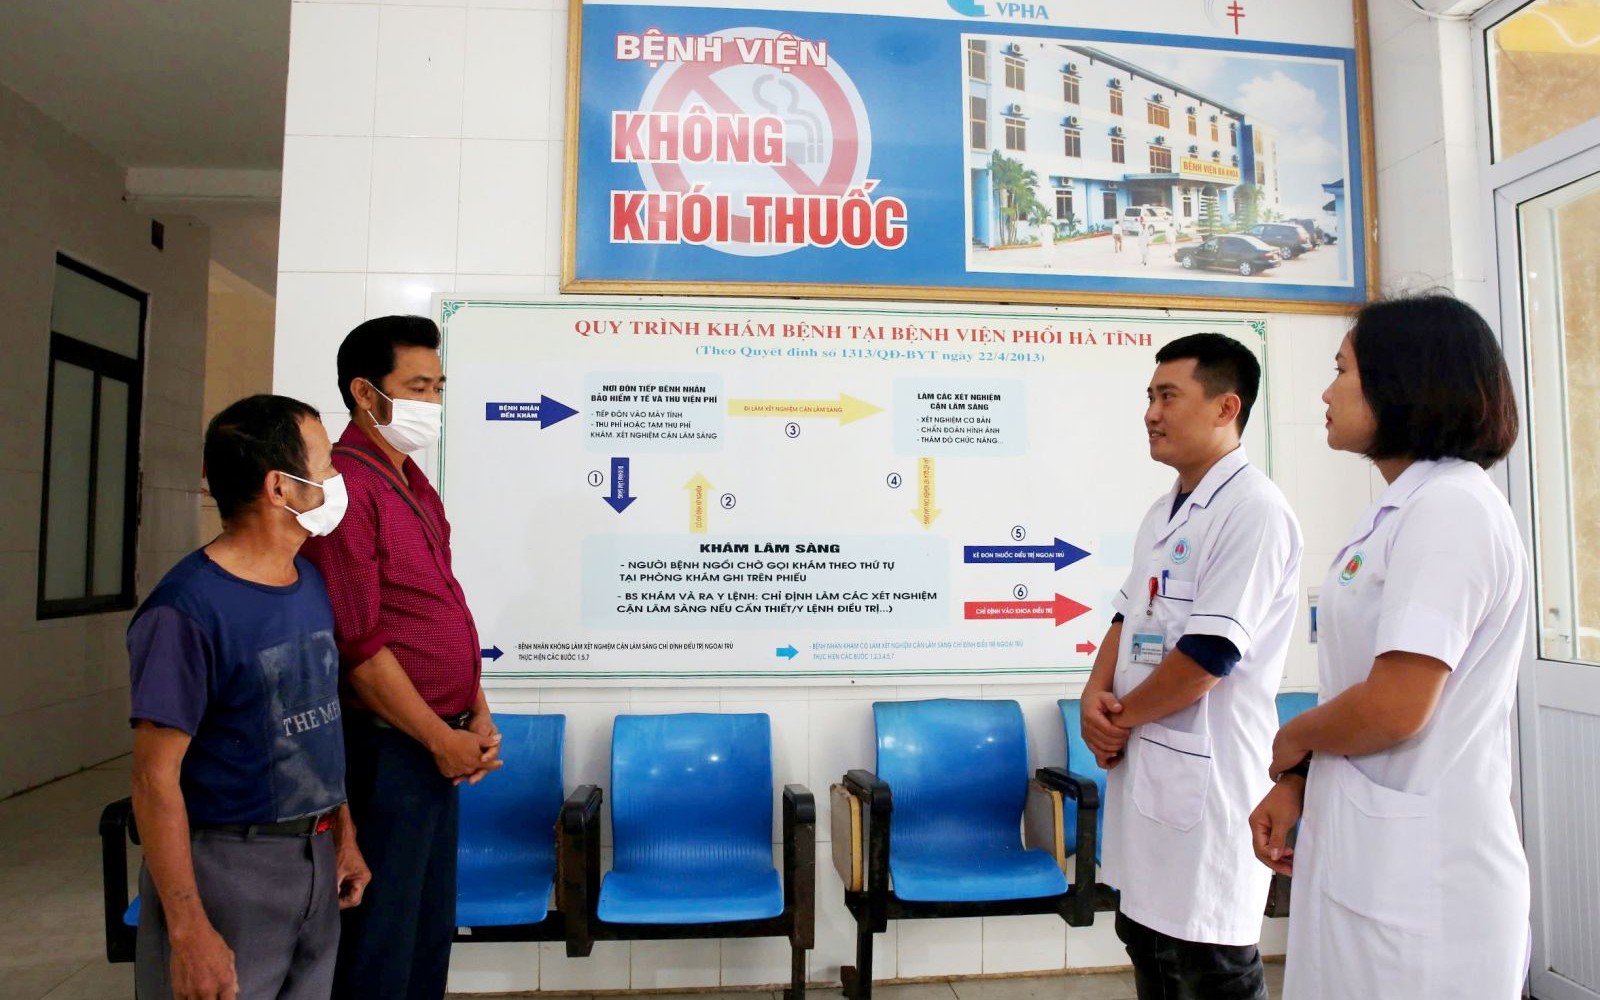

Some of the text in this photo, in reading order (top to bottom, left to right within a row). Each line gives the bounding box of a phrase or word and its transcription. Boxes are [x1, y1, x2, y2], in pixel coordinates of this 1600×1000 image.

[996, 2, 1049, 19] VPHA
[616, 27, 828, 74] BỆNH VIỆN
[611, 104, 786, 166] KHÔNG
[610, 179, 908, 250] KHÓI THUỐC
[574, 317, 1153, 347] QUY TRÌNH KHÁM BỆNH TẠI BỆNH VIỆN PHỔI HÀ TĨNH
[695, 345, 1045, 363] (Theo Quyết định số 1313/QĐ-BYT ngày 22/4/2013)
[699, 542, 841, 553] KHÁM LÂM SÀNG
[628, 559, 667, 569] NGƯỜI
[670, 559, 699, 571] BỆNH
[736, 559, 764, 569] CHỜ
[766, 561, 789, 571] GỌI
[792, 559, 826, 569] KHÁM
[828, 561, 857, 570] THEO
[859, 559, 880, 569] THỨ
[882, 561, 895, 571] TỰ
[619, 572, 807, 583] TẠI PHÒNG KHÁM GHI TRÊN PHIẾU
[625, 590, 937, 602] BS KHÁM VÀ RA Y LỆNH: CHỈ ĐỊNH LÀM CÁC XÉT NGHIỆM
[616, 603, 643, 614] CẬN
[646, 603, 671, 613] LÂM
[674, 603, 707, 613] SÀNG
[710, 603, 732, 613] NẾU
[764, 603, 803, 613] THIẾT/Y
[806, 603, 834, 614] LỆNH
[837, 603, 862, 613] ĐIỀU
[283, 708, 320, 737] THE
